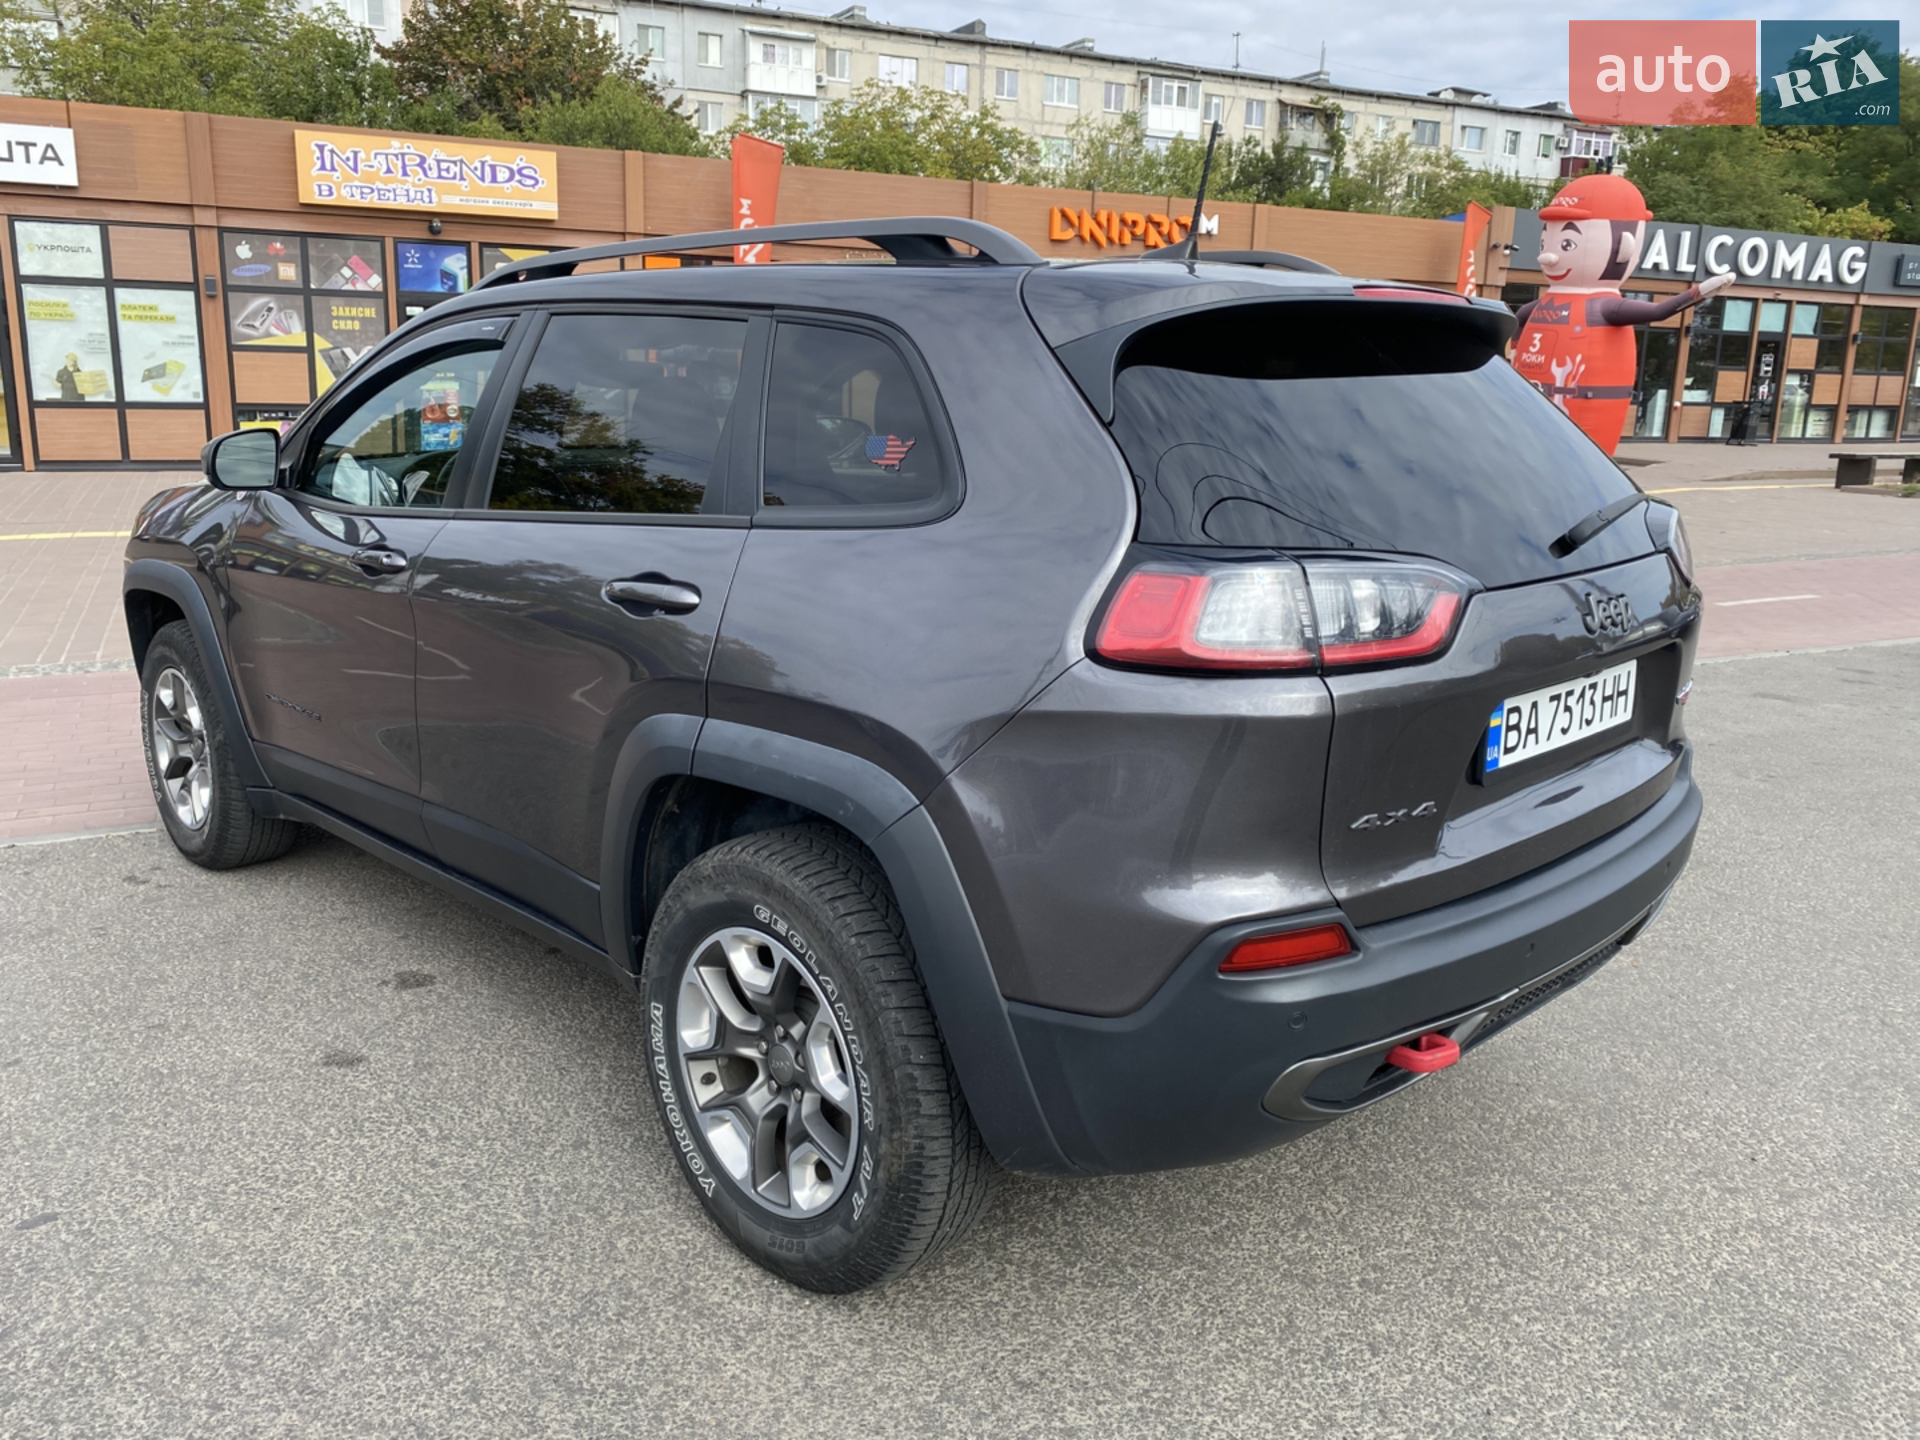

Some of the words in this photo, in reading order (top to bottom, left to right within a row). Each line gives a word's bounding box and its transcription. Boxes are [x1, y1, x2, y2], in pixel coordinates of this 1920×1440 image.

[314, 143, 541, 188] IN-TRENDS
[315, 183, 334, 197] В
[343, 184, 435, 204] ТРЕНДІ
[35, 243, 93, 254] УКРПОШТА
[1641, 228, 1868, 285] ALCOMAG
[120, 304, 158, 312] ПЛАТЕЖІ
[134, 314, 175, 322] ПЕРЕКАЗИ
[331, 306, 377, 318] ЗАХИСНЕ
[332, 319, 361, 331] СКЛО
[1529, 333, 1543, 353] 3
[1521, 352, 1546, 364] РОКИ
[1582, 592, 1633, 636] Jeep
[1502, 700, 1540, 756] BA
[1545, 682, 1599, 742] 7513
[1599, 669, 1633, 725] HH
[1486, 745, 1499, 761] UA
[753, 904, 875, 1132] GEOLANDAR
[852, 1145, 875, 1222] A/T
[650, 1001, 716, 1199] YOKOHAMA
[767, 1234, 806, 1254] G015
